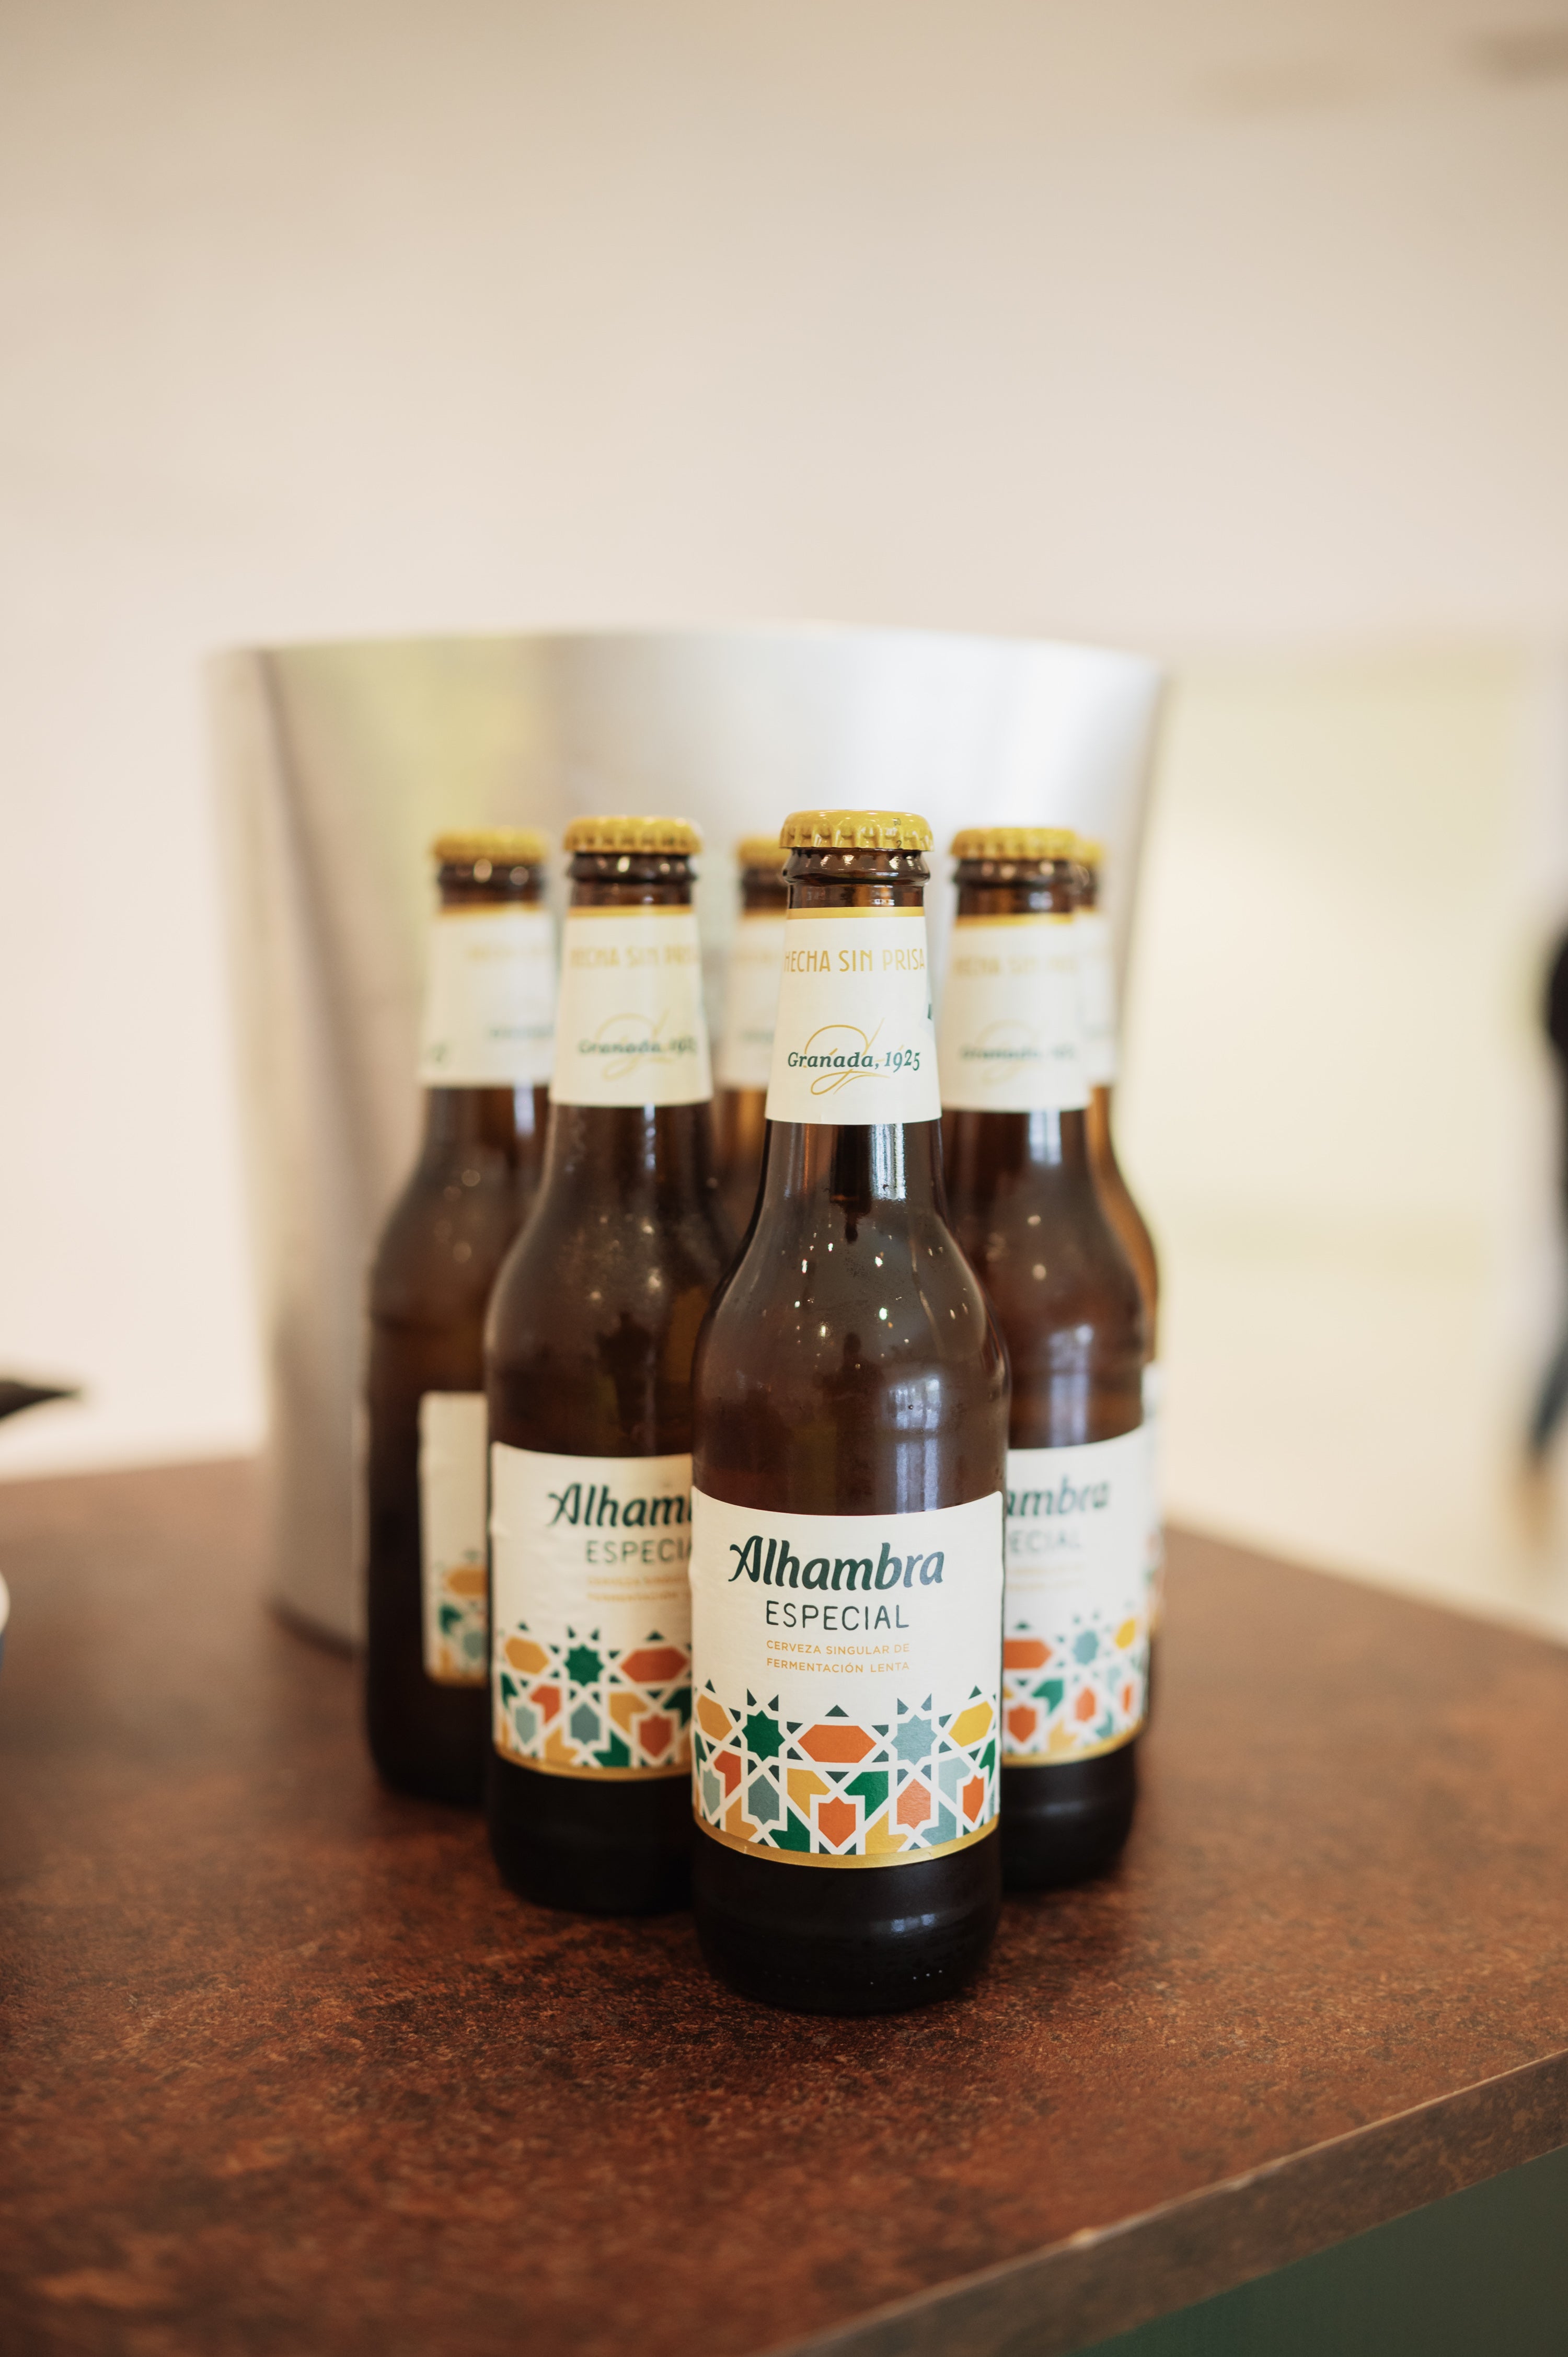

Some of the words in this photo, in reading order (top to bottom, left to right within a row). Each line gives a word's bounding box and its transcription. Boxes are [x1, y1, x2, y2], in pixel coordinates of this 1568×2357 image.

[784, 950, 831, 972] HECHA
[838, 949, 873, 972] SIN
[881, 948, 926, 971] PRISA
[788, 1052, 879, 1070] Granada,
[884, 1049, 921, 1073] 1925
[546, 1482, 692, 1527] Alham
[586, 1537, 692, 1564] ESPECI
[728, 1535, 945, 1591] Alhambra
[766, 1600, 910, 1631] ESPECIAL
[766, 1640, 822, 1654] CERVEZA
[826, 1644, 890, 1655] SINGULAR
[894, 1643, 910, 1653] DE
[766, 1658, 863, 1673] FERMENTACIÓN
[870, 1661, 910, 1673] LENTA
